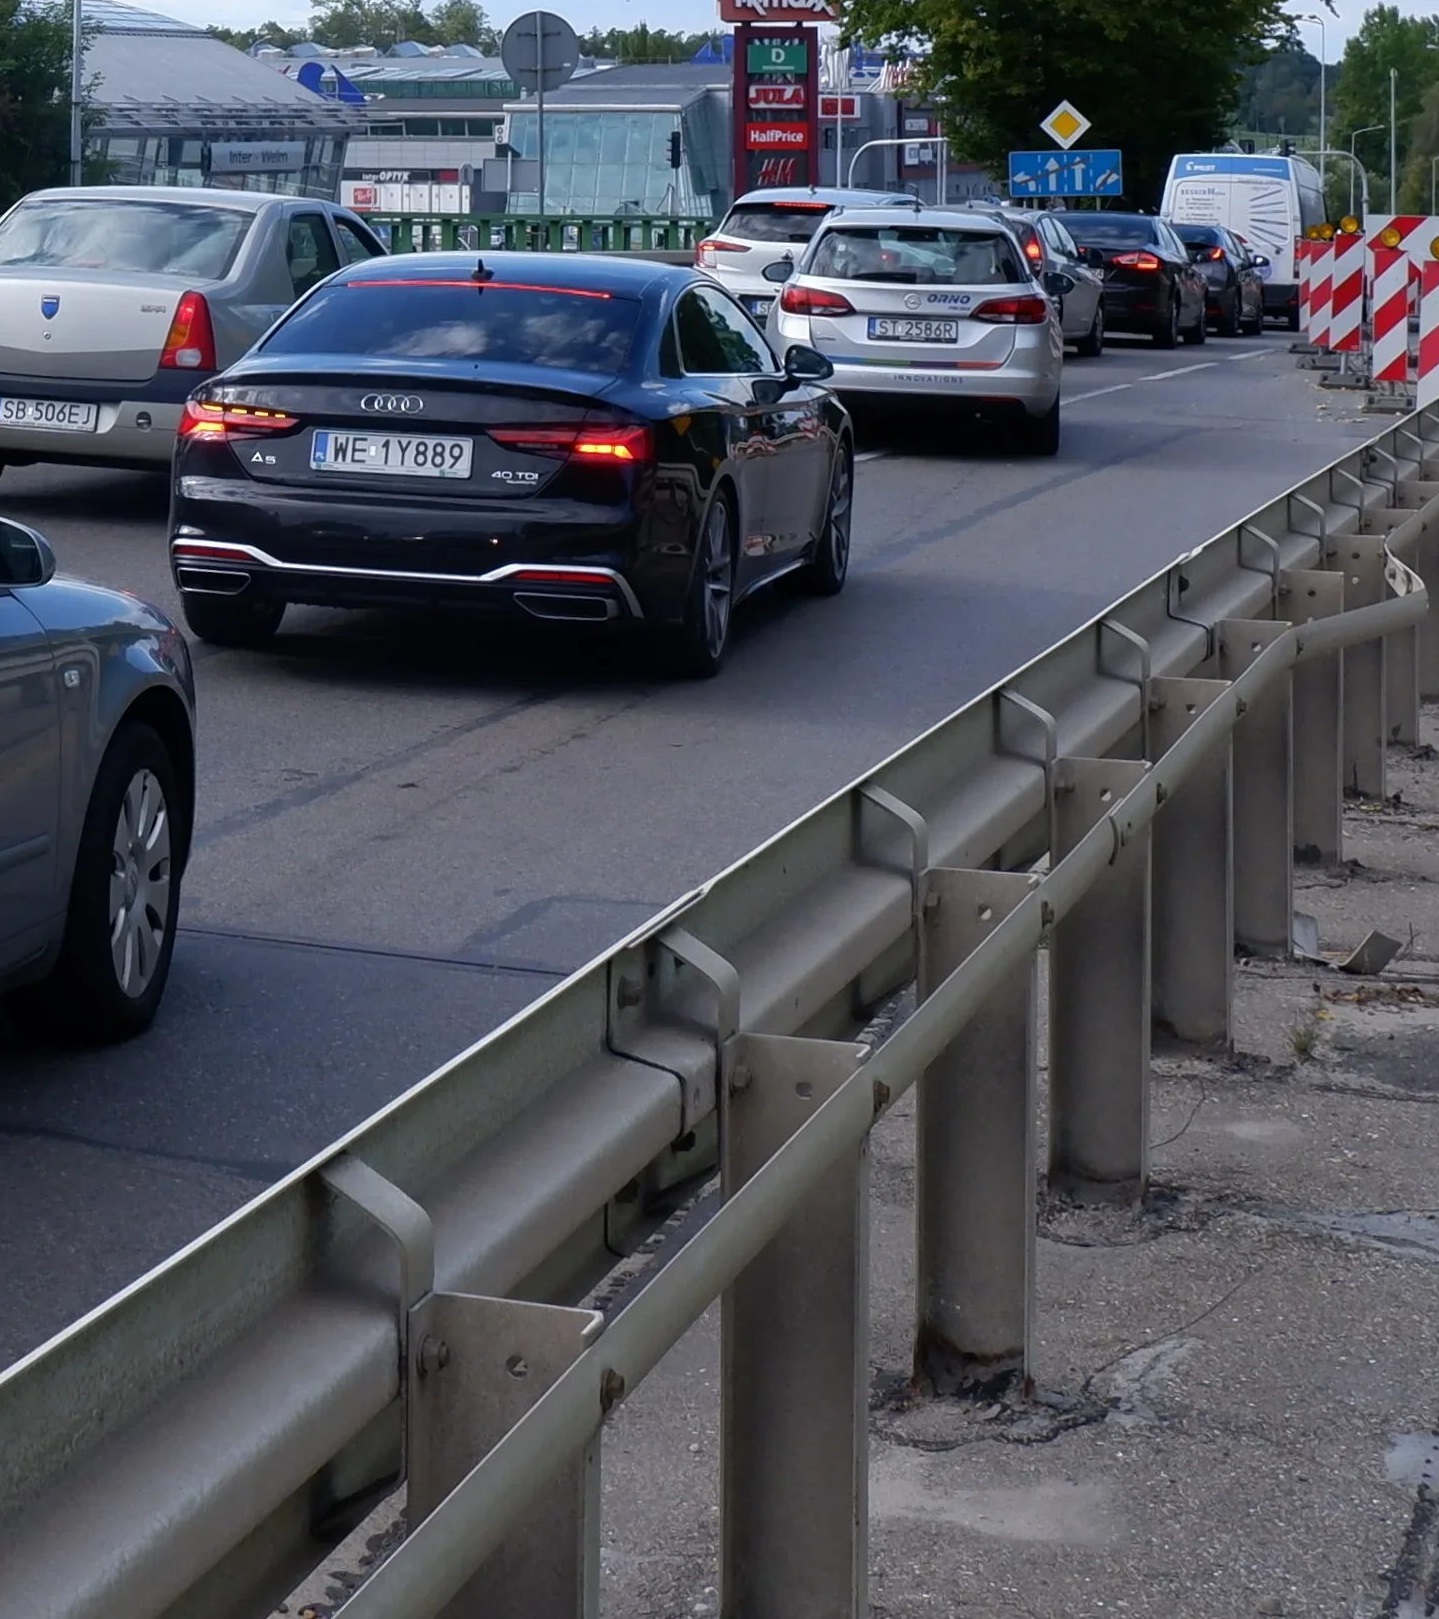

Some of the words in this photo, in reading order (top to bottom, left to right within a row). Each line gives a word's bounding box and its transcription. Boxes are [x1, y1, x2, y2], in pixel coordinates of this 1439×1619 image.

[771, 48, 786, 63] D
[749, 88, 804, 105] JULA
[750, 130, 804, 143] HalfPrice
[229, 150, 253, 164] Inter
[927, 293, 971, 305] ORNO
[879, 320, 899, 335] ST
[905, 322, 953, 338] 2586R
[3, 400, 27, 420] SB
[34, 402, 92, 425] 506EJ
[333, 436, 368, 464] WE
[381, 439, 464, 469] 1Y889
[491, 471, 513, 479] 40
[515, 471, 539, 480] TDI
